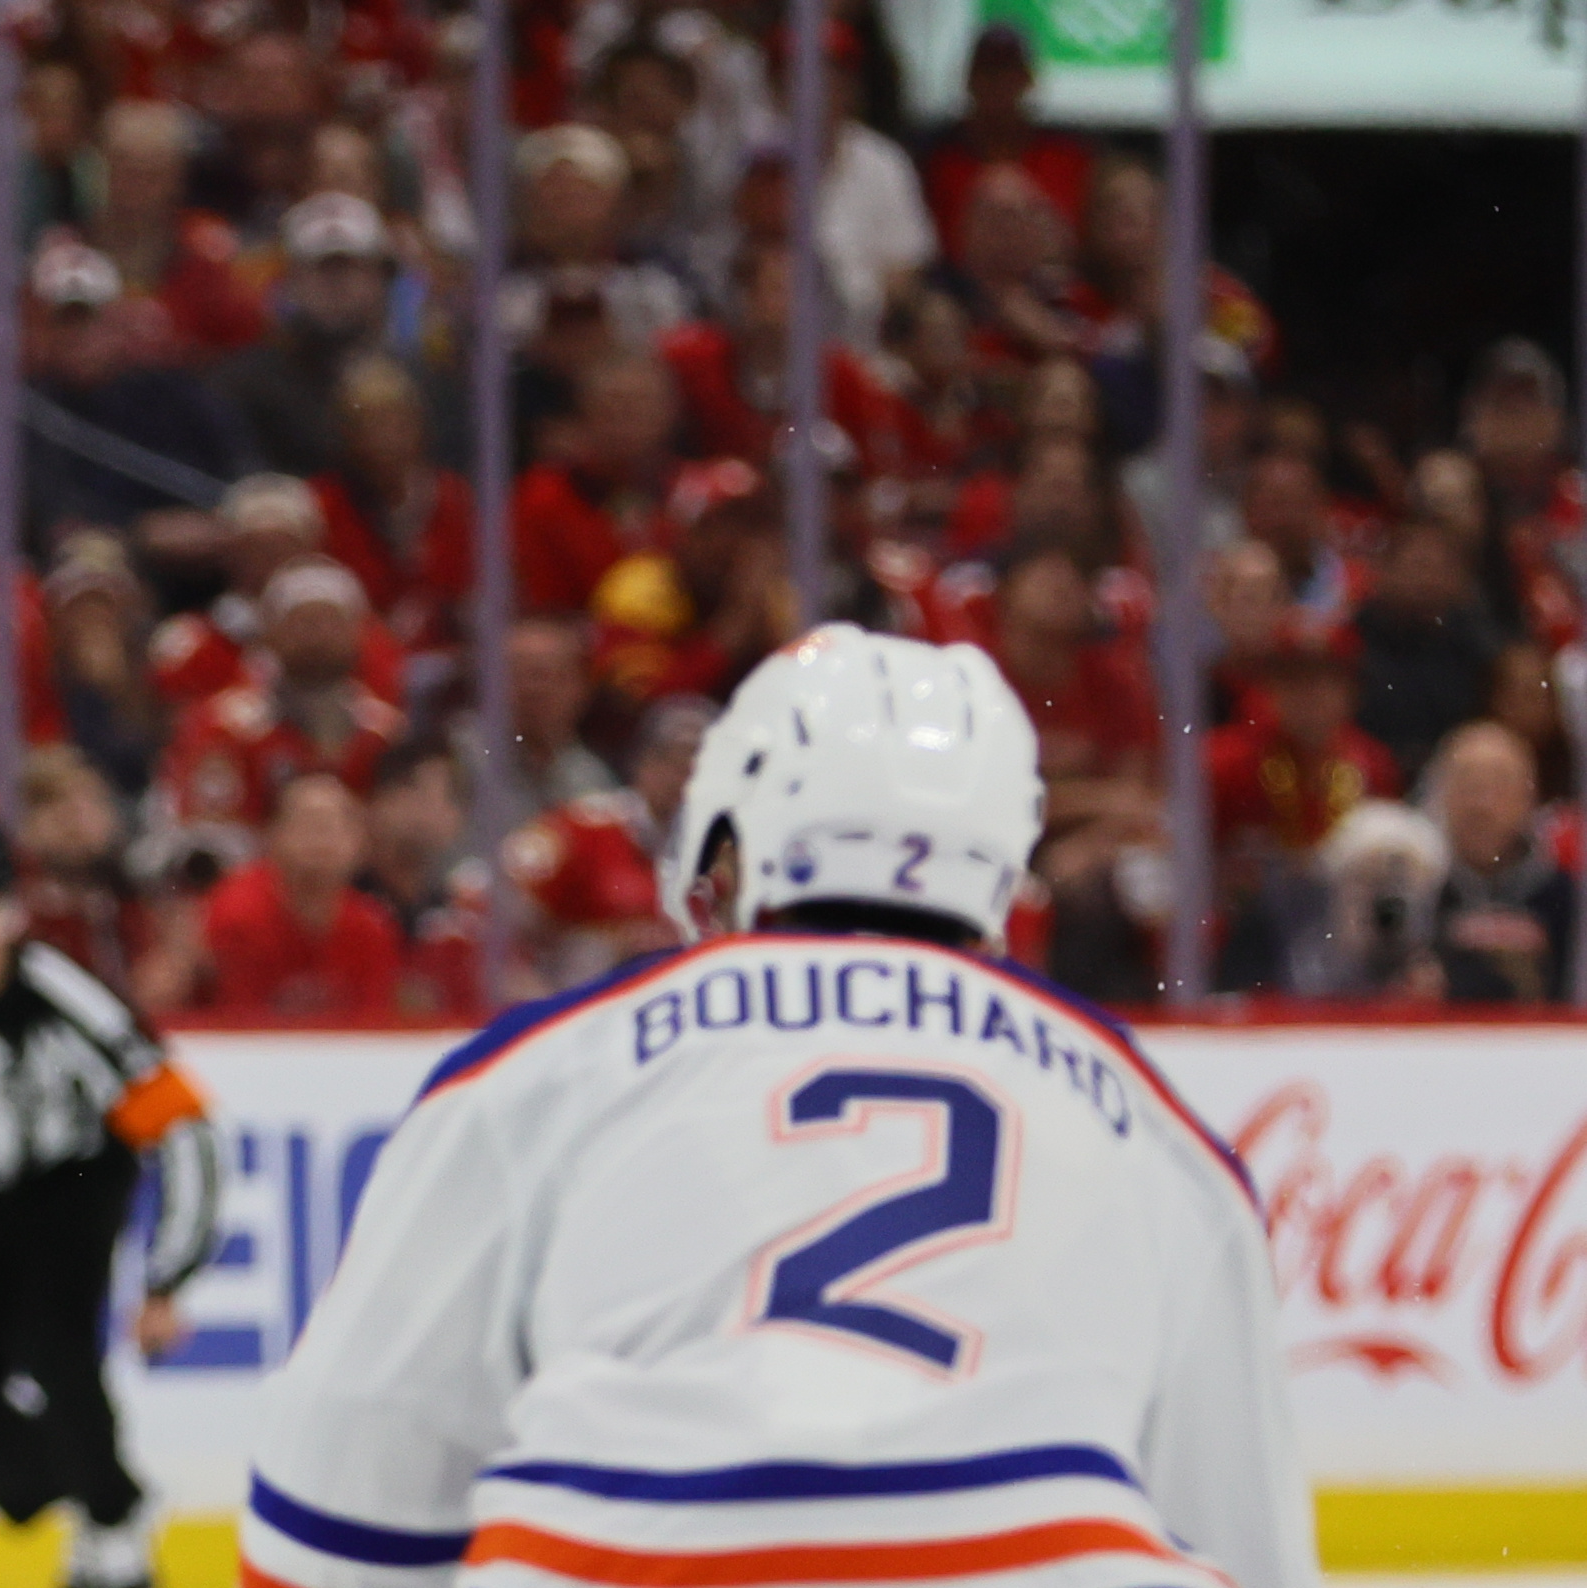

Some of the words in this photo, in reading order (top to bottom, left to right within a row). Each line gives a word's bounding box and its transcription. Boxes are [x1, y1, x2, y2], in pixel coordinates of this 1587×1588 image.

[893, 832, 932, 892] 2
[633, 961, 1134, 1139] BOUCHARD
[739, 1055, 1022, 1380] 2
